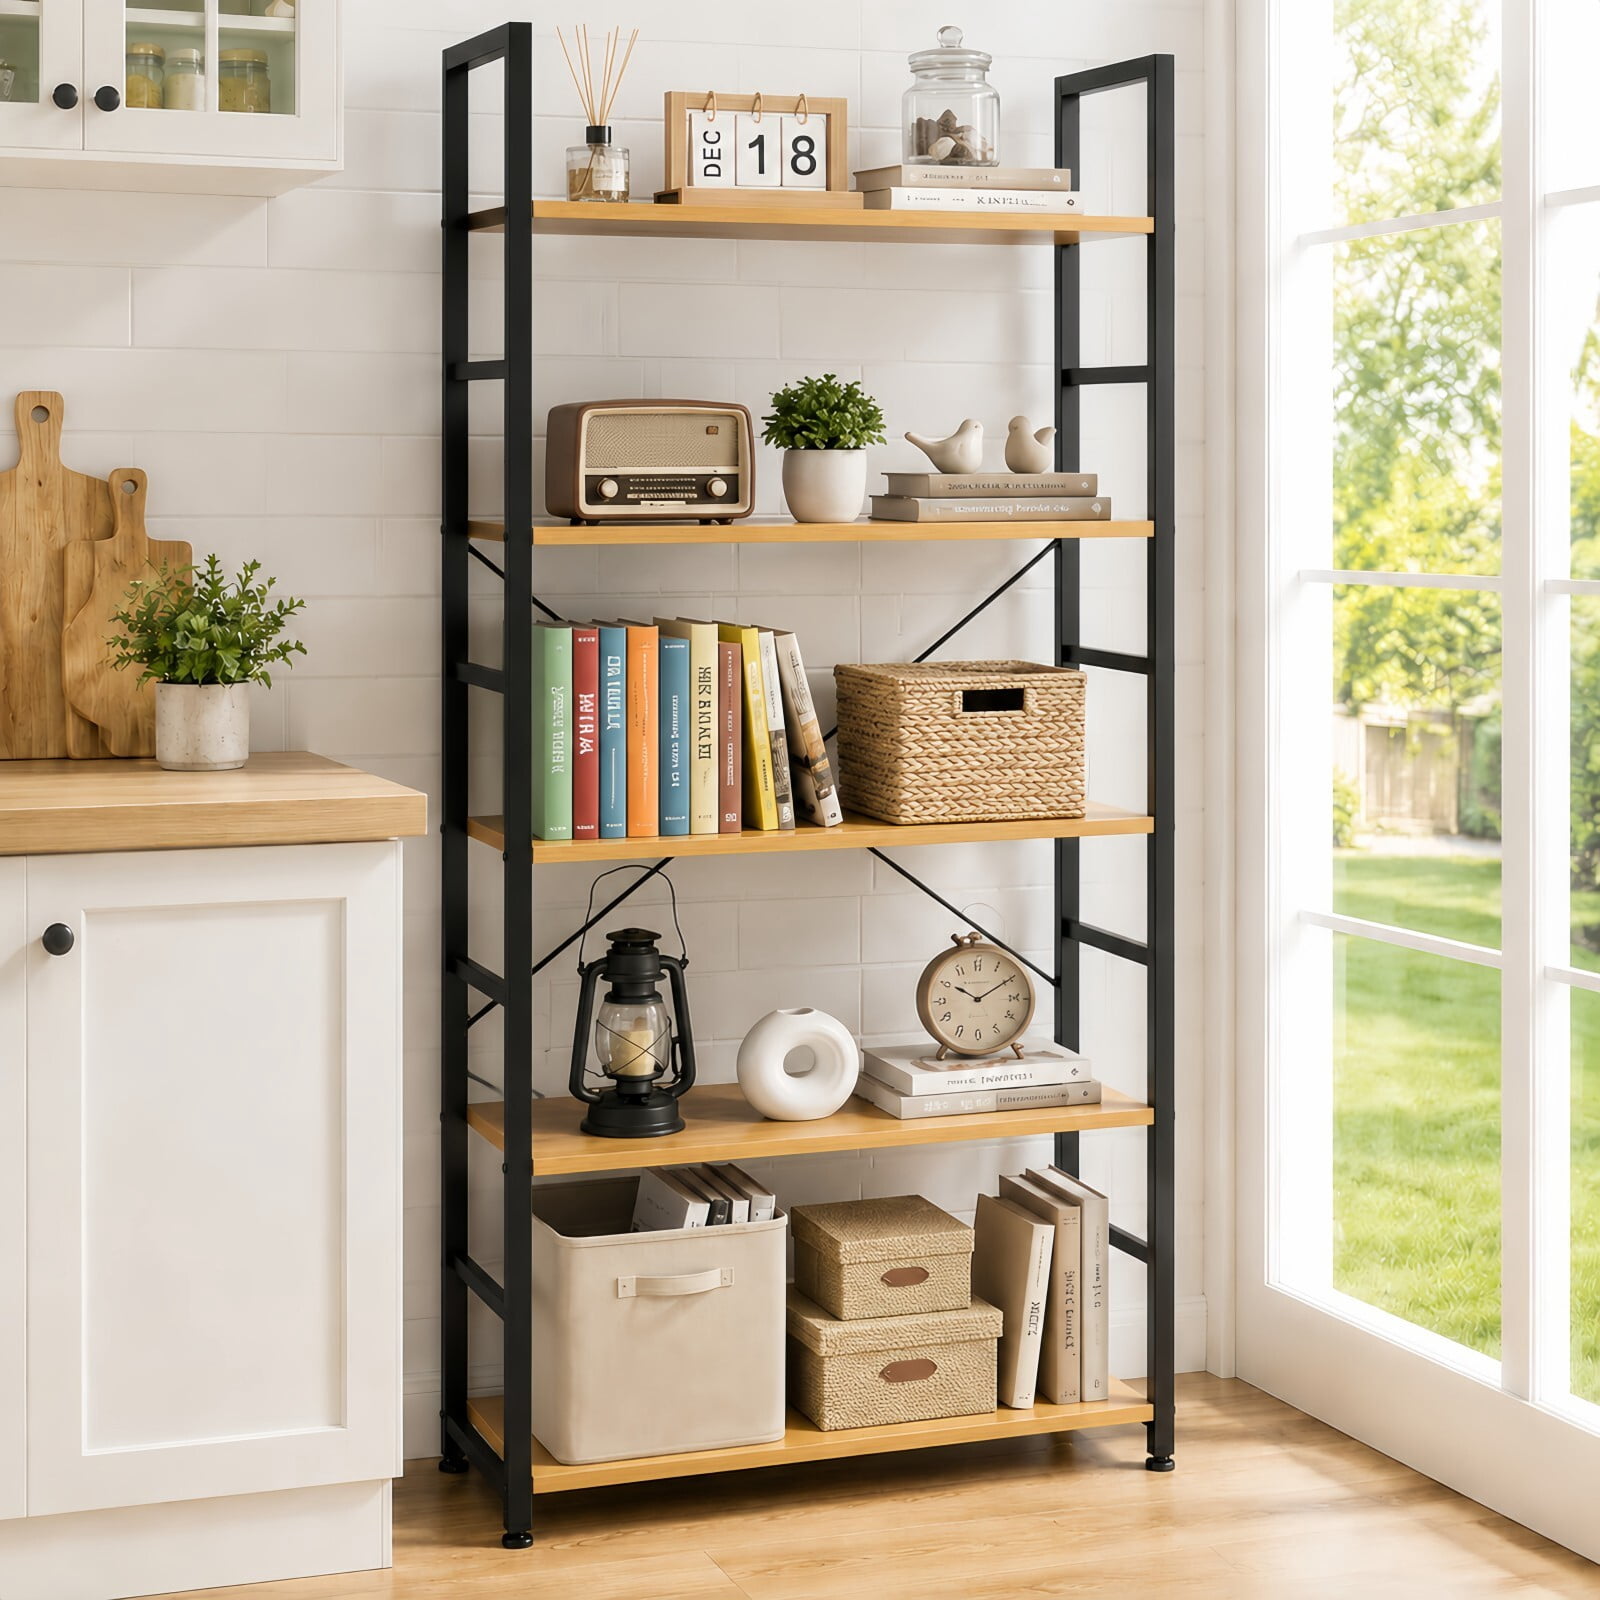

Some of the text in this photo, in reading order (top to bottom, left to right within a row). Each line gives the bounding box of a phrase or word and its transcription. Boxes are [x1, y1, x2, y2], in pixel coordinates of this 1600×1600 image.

[703, 130, 721, 177] DEC
[748, 134, 817, 176] 1 8
